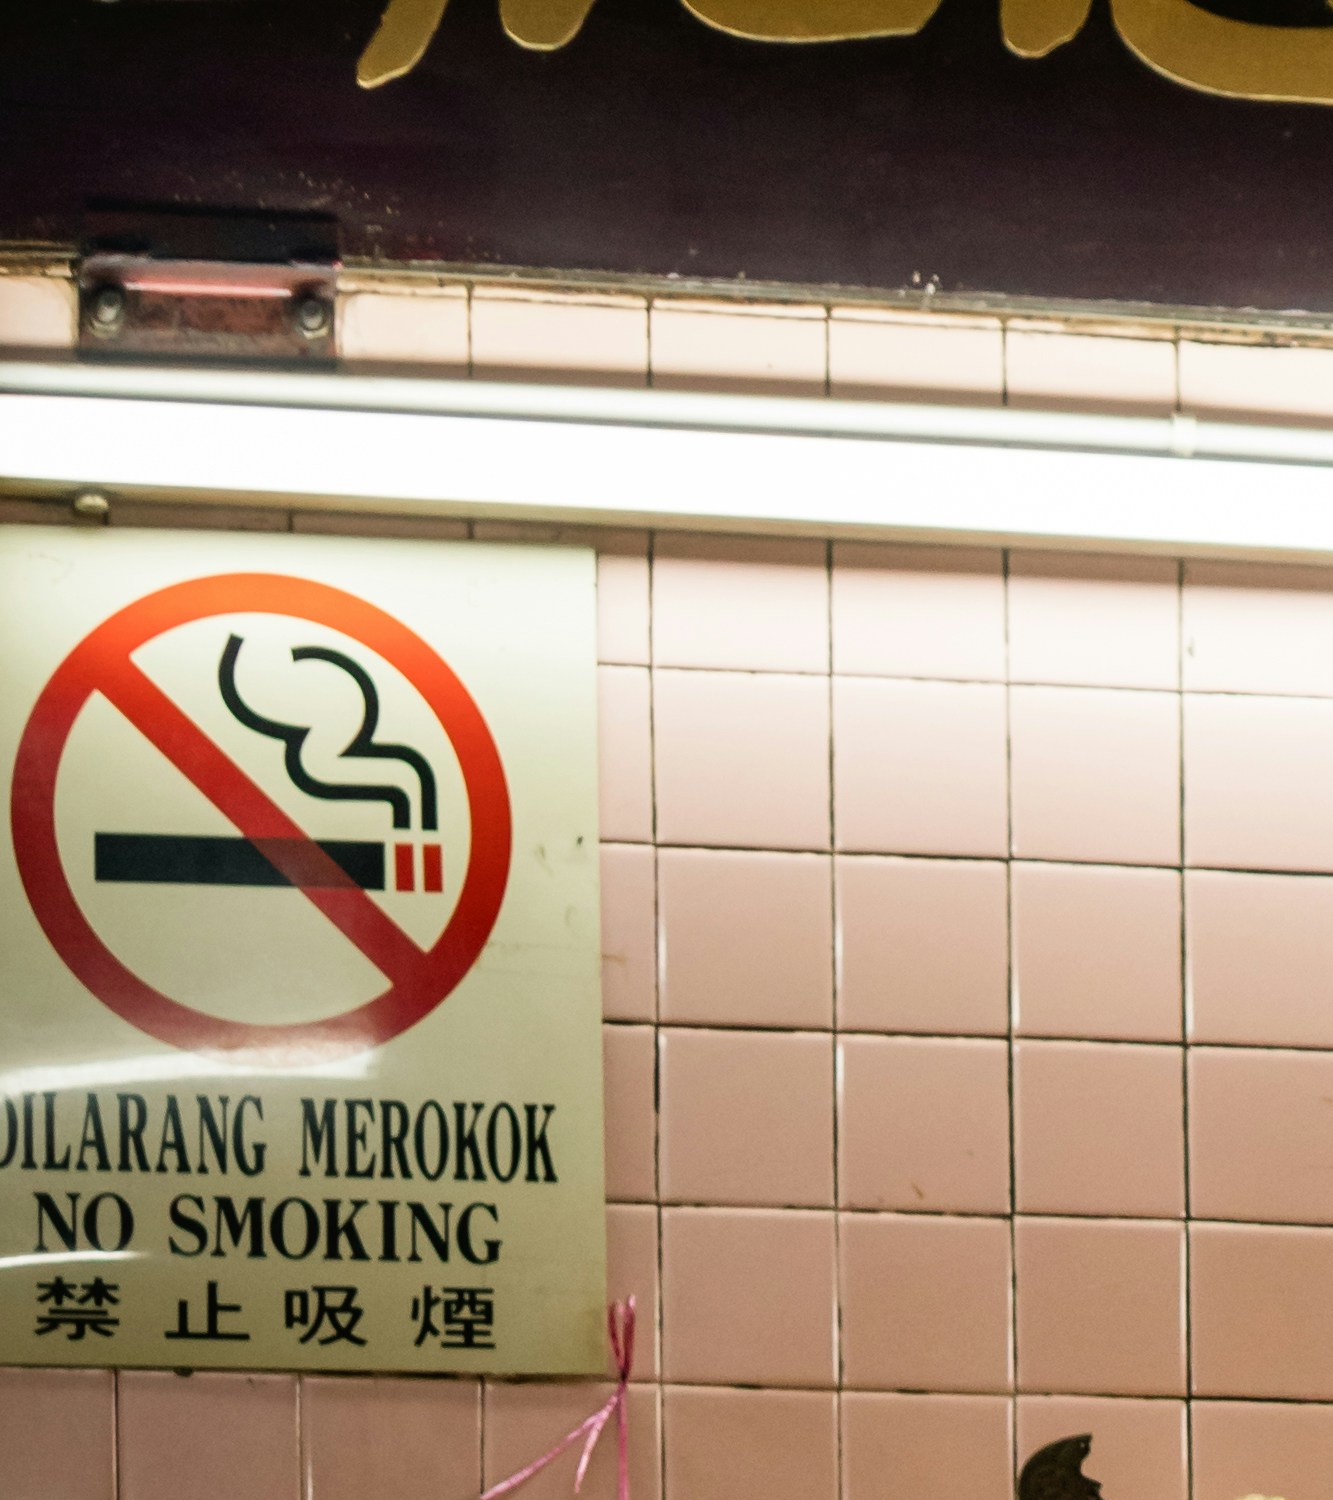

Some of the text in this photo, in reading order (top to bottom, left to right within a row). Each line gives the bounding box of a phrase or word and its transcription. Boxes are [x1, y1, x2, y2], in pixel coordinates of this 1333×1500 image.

[300, 1096, 558, 1184] MEROKOK
[33, 1191, 503, 1265] NO SMOKING
[34, 1275, 497, 1350] 禁止吸煙
